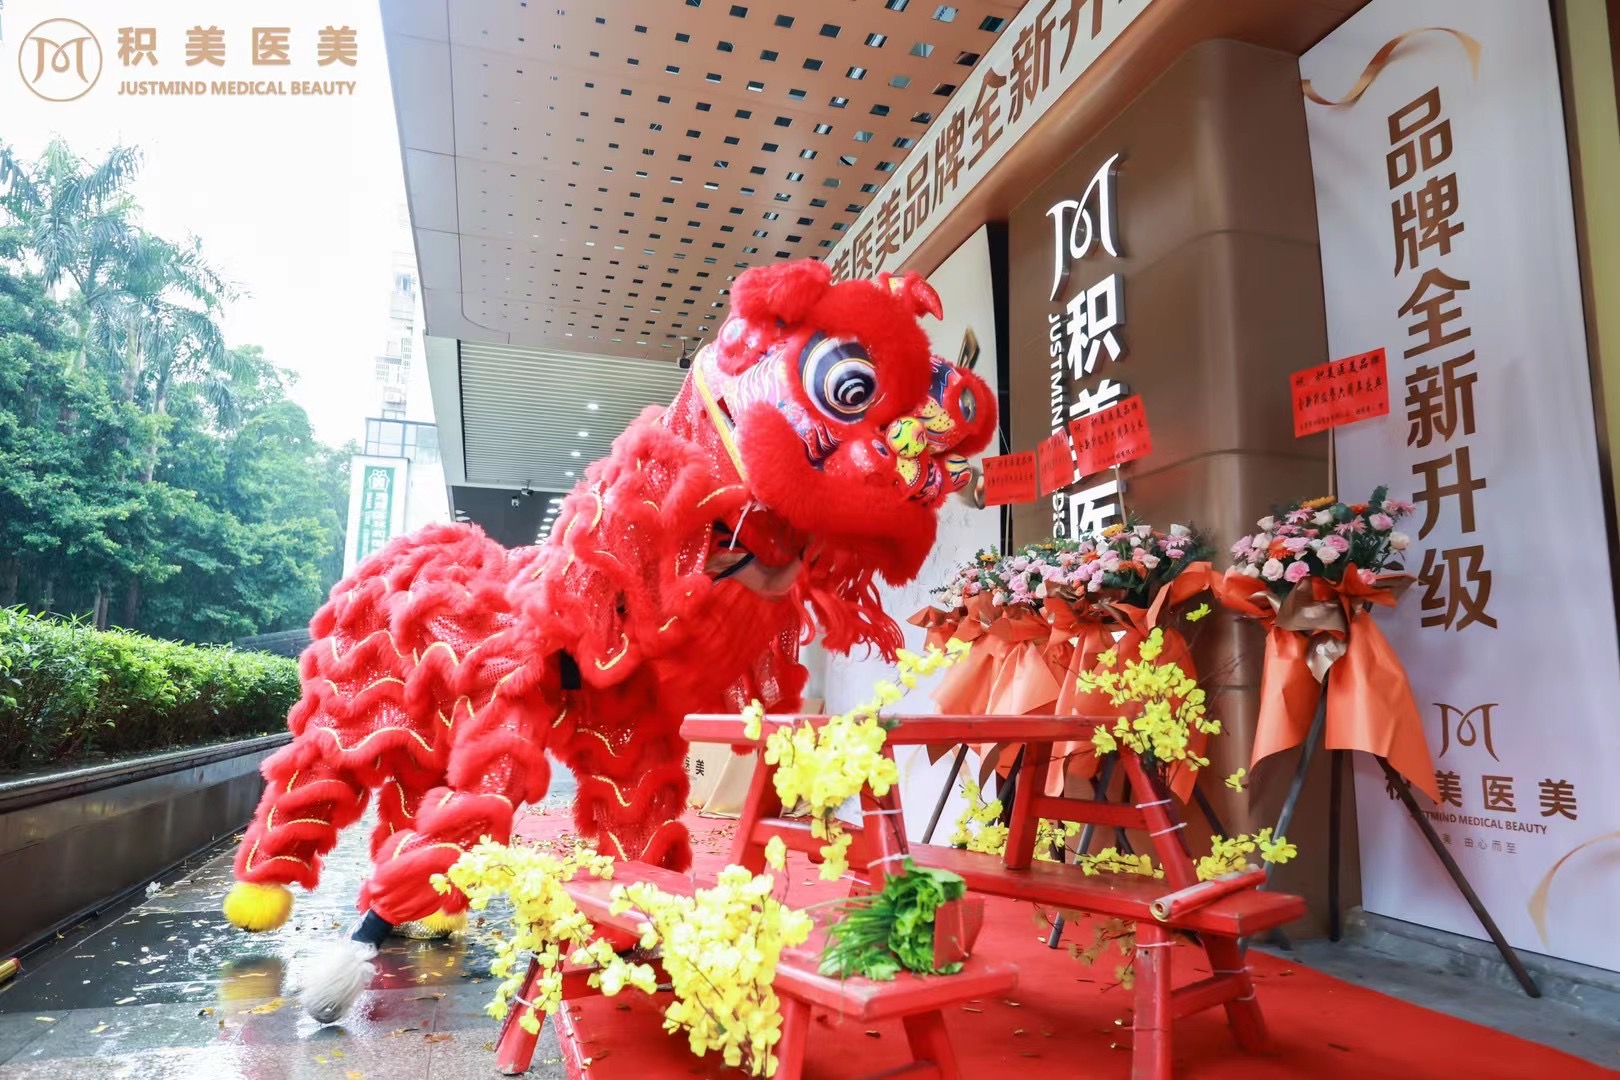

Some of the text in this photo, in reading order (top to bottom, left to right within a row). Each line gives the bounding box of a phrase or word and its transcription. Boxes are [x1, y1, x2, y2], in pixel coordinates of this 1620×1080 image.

[1386, 86, 1498, 632] 品牌全新升级
[1458, 815, 1503, 830] MEDICAL
[1505, 820, 1547, 835] BEAUTY
[1464, 837, 1517, 854] 由心而至
